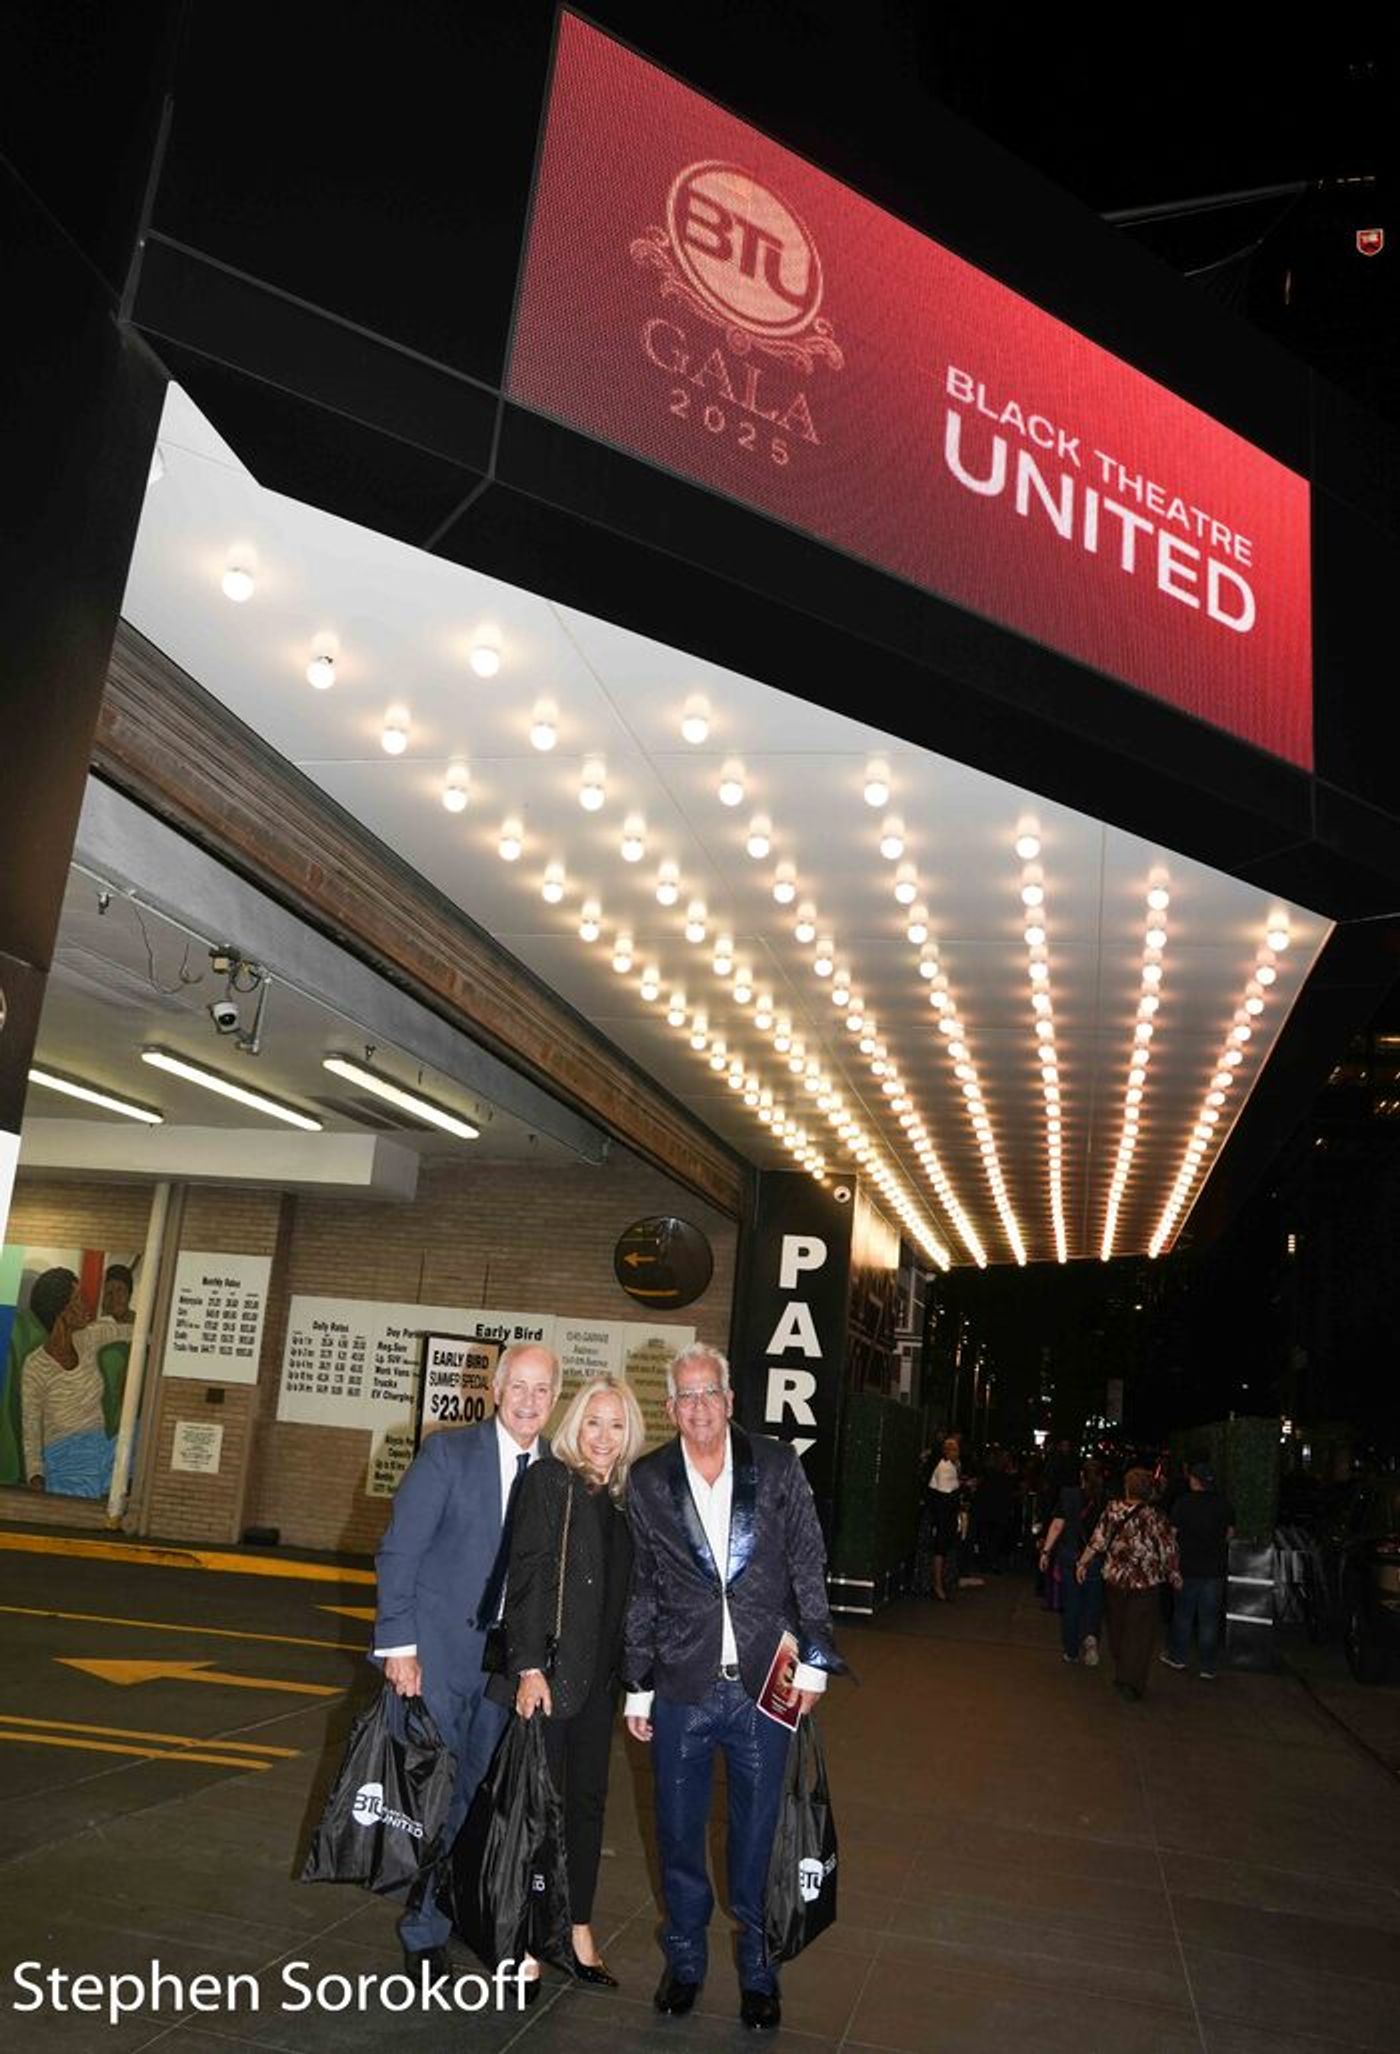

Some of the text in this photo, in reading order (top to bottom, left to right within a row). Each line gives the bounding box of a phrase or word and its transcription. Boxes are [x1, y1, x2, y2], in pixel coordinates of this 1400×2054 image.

[679, 189, 814, 302] BTU
[641, 317, 822, 447] GALA
[669, 389, 792, 467] 2025
[946, 364, 1255, 568] BLACK THEATRE
[943, 410, 1258, 635] UNITED
[312, 1320, 349, 1333] Daily Rates
[386, 1327, 401, 1339] Day
[475, 1323, 544, 1342] Early Bird
[433, 1350, 465, 1367] EARLY
[465, 1352, 490, 1369] BIRD
[374, 1377, 397, 1388] Trucks
[428, 1371, 490, 1391] SUMMER SPECIAL
[371, 1389, 382, 1399] EV
[383, 1390, 415, 1405] Charging
[430, 1393, 485, 1421] $23.00
